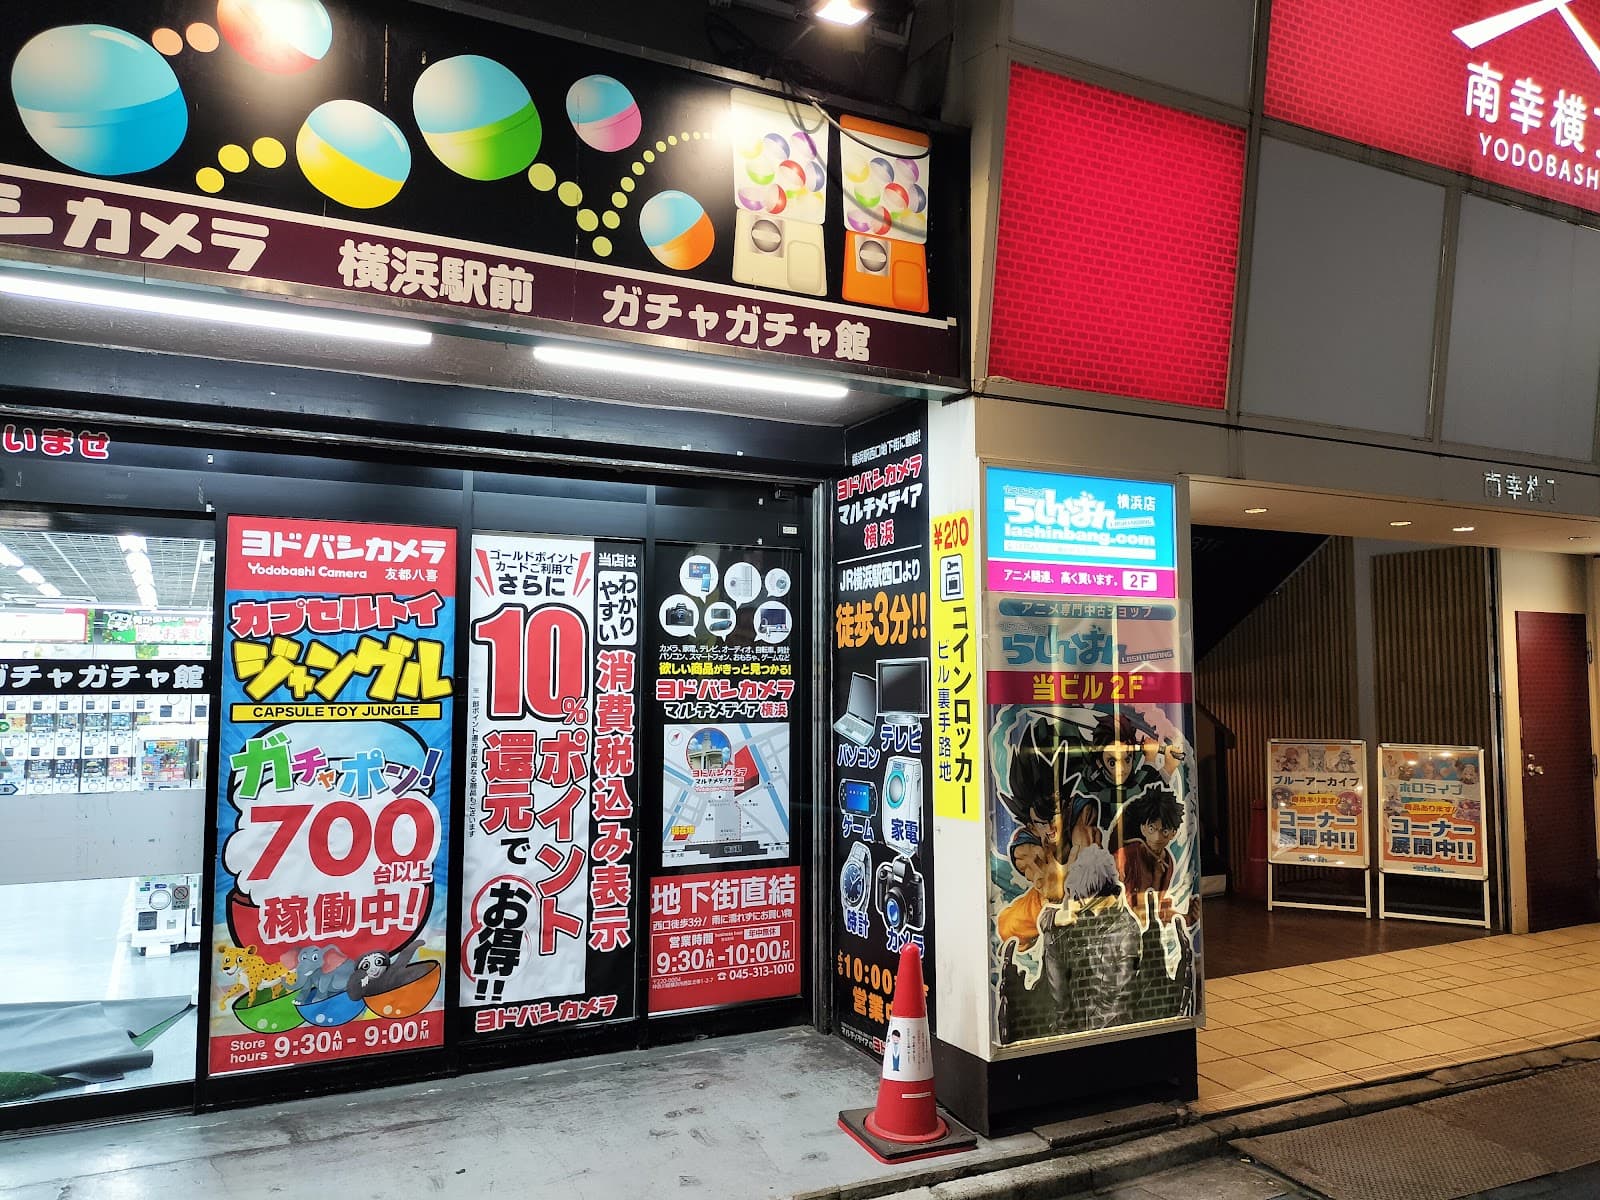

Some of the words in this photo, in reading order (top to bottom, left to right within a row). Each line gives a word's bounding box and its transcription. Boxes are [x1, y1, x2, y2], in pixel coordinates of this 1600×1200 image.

[1466, 62, 1600, 159] 南幸横
[1479, 133, 1600, 190] YODOBASH
[338, 239, 534, 312] 横浜駅前
[602, 285, 871, 362] ガチャガチャ館
[2, 424, 110, 459] いませ
[837, 454, 923, 501] ヨドバシカメラ
[838, 483, 923, 525] マルチメディア
[1117, 493, 1156, 512] 横浜店
[241, 529, 447, 564] ヨドバシカメラ
[864, 519, 894, 550] 横浜
[934, 516, 969, 551] ¥200
[1004, 522, 1156, 547] lashinbang.com
[247, 562, 316, 577] Yodobashi
[317, 566, 368, 579] Camera
[489, 549, 579, 564] ゴールドポイント
[495, 561, 574, 576] カードご利用で
[598, 552, 637, 568] 当店は
[384, 567, 439, 582] 友都八喜
[498, 572, 566, 597] さらに
[839, 558, 921, 592] JR横浜駅西口より
[1130, 573, 1150, 588] 2F
[230, 591, 443, 638] カプセルトイ
[599, 580, 619, 642] やすい
[618, 574, 638, 637] わかり
[836, 591, 927, 649] 徒歩3分!!
[233, 634, 454, 701] ジャングル
[471, 603, 589, 725] 10%
[659, 662, 792, 675] 欲しい商品がきっと見つかる!
[1121, 650, 1174, 664] LASHINBANG
[0, 664, 205, 689] チャガチャ館
[656, 679, 795, 700] ヨドバシカメラ
[1032, 673, 1104, 702] 当ビル
[1110, 674, 1144, 700] 2F
[252, 706, 325, 718] CAPSULE
[327, 706, 358, 718] TOY
[361, 705, 420, 717] JUNGLE
[664, 701, 788, 719] マルチメディア横浜
[937, 639, 952, 782] ビル裏手路地
[952, 606, 973, 814] コインロッカー
[880, 724, 922, 753] テレビ
[230, 732, 442, 799] ガチャポン!
[837, 743, 880, 769] パソコン
[1273, 775, 1360, 787] ブルーアーカイブ
[479, 730, 537, 865] 還元で
[589, 650, 637, 953] 消費税込み表示
[842, 814, 874, 843] ゲーム
[891, 818, 919, 845] 家電
[1279, 811, 1355, 828] コーナー
[1391, 818, 1473, 838] コーナー
[246, 797, 435, 881] 700
[536, 730, 588, 956] ポイント
[1390, 836, 1474, 860] 展開中!!
[373, 863, 433, 885] 台以上
[651, 873, 796, 915] 地下街直結
[263, 889, 427, 940] 稼働中!
[845, 909, 870, 939] 時計
[473, 882, 533, 1002] お得!!
[669, 932, 714, 949] 営業時間
[656, 949, 704, 974] 9:30
[725, 940, 781, 966] 10:00
[729, 963, 795, 981] 045-313-1010
[475, 994, 619, 1033] ヨドバシカメラ
[853, 986, 894, 1025] 営業
[230, 1037, 266, 1051] Store
[274, 1032, 332, 1058] 9:30
[364, 1021, 418, 1046] 9:00
[230, 1051, 268, 1064] hours
